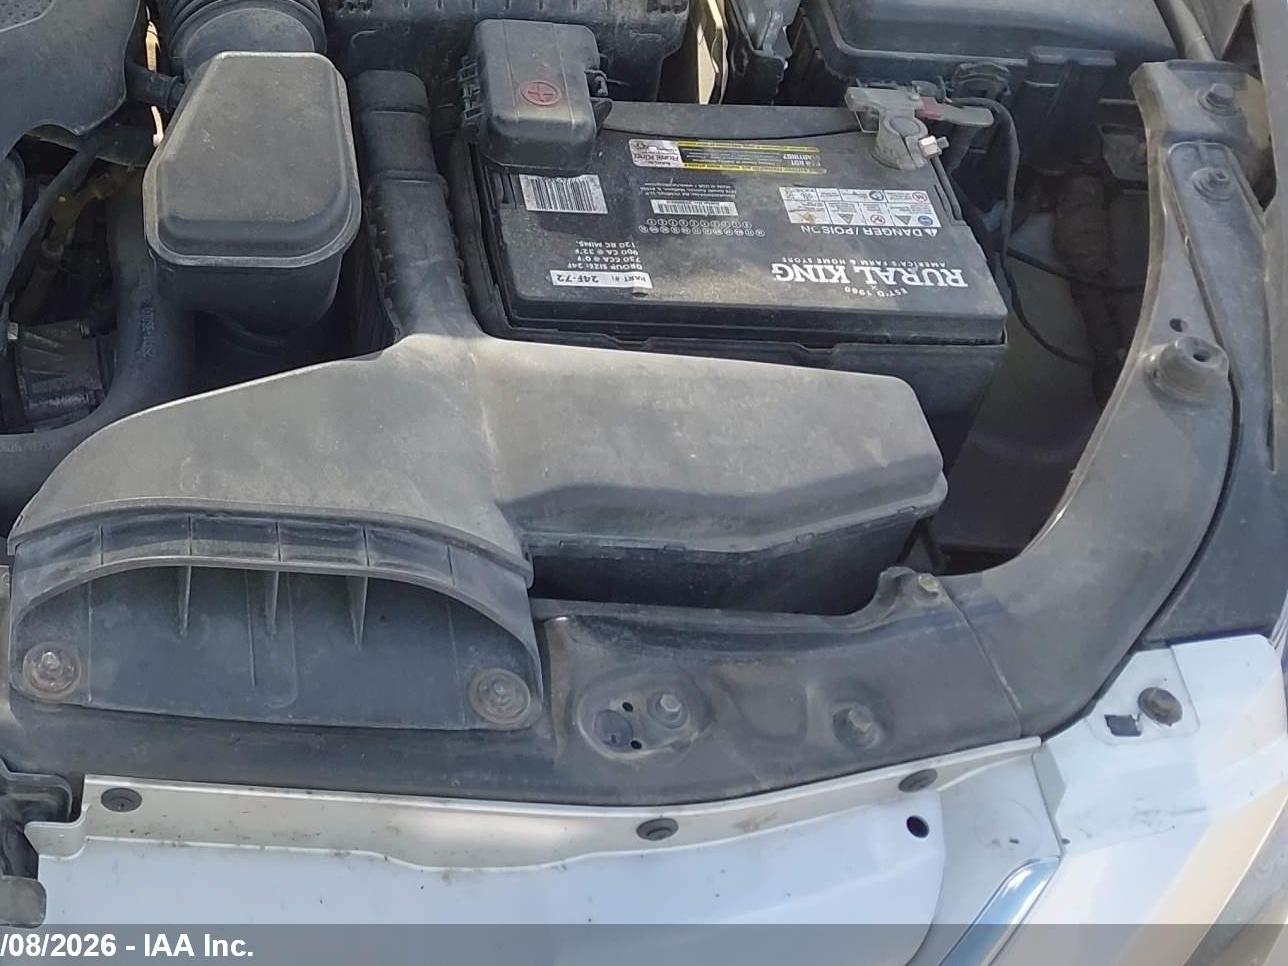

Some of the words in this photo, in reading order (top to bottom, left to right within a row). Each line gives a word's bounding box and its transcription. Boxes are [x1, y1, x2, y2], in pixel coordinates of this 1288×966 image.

[863, 227, 923, 237] DANGER
[557, 274, 599, 283] 24F-72
[771, 263, 851, 284] KING
[854, 266, 968, 288] RURAL
